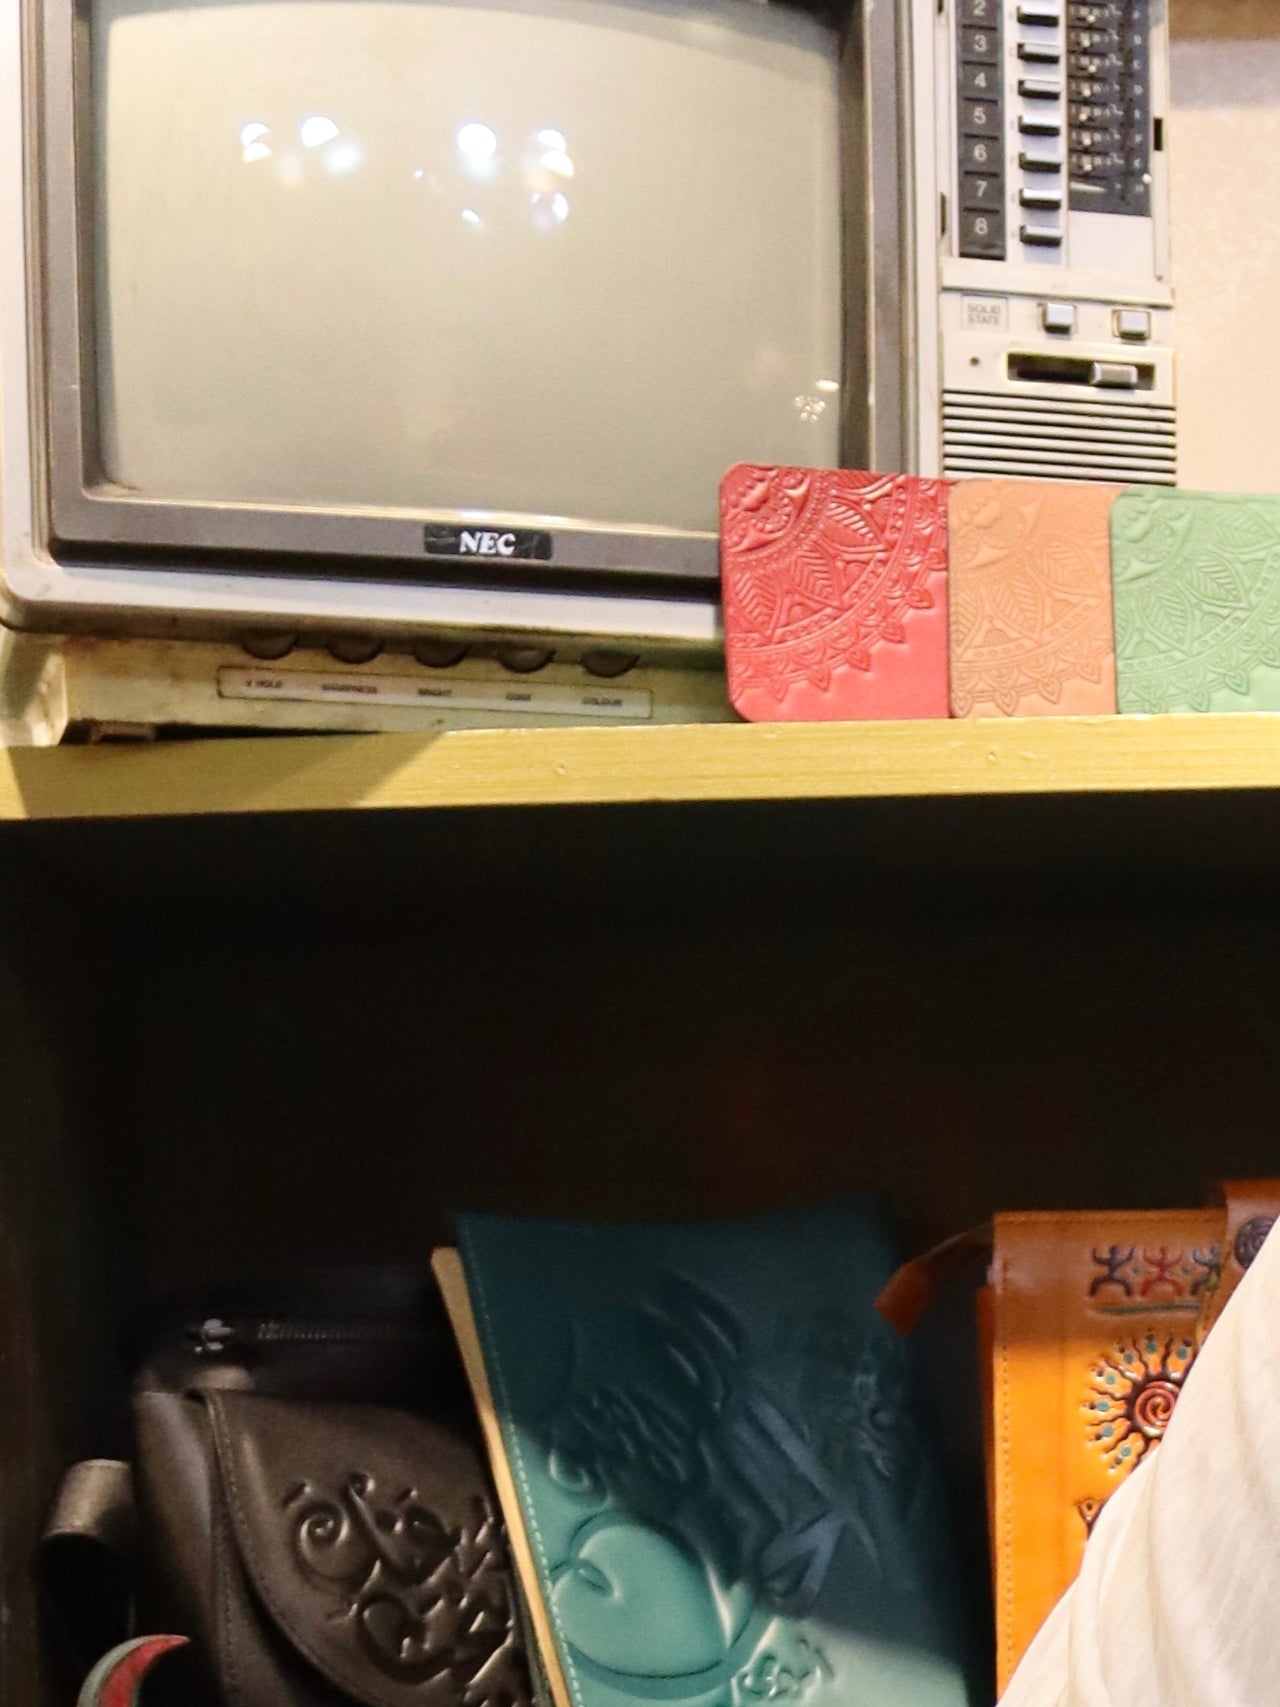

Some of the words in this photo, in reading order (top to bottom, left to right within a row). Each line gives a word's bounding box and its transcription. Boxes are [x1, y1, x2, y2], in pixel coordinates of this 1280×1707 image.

[973, 0, 986, 16] 2
[974, 35, 987, 51] 3
[974, 72, 987, 88] 4
[973, 107, 987, 125] 5
[974, 143, 988, 161] 6
[975, 180, 988, 198] 7
[974, 217, 988, 235] 8
[967, 303, 1002, 315] SOLID
[967, 313, 1001, 326] STATE
[459, 530, 517, 556] NEC
